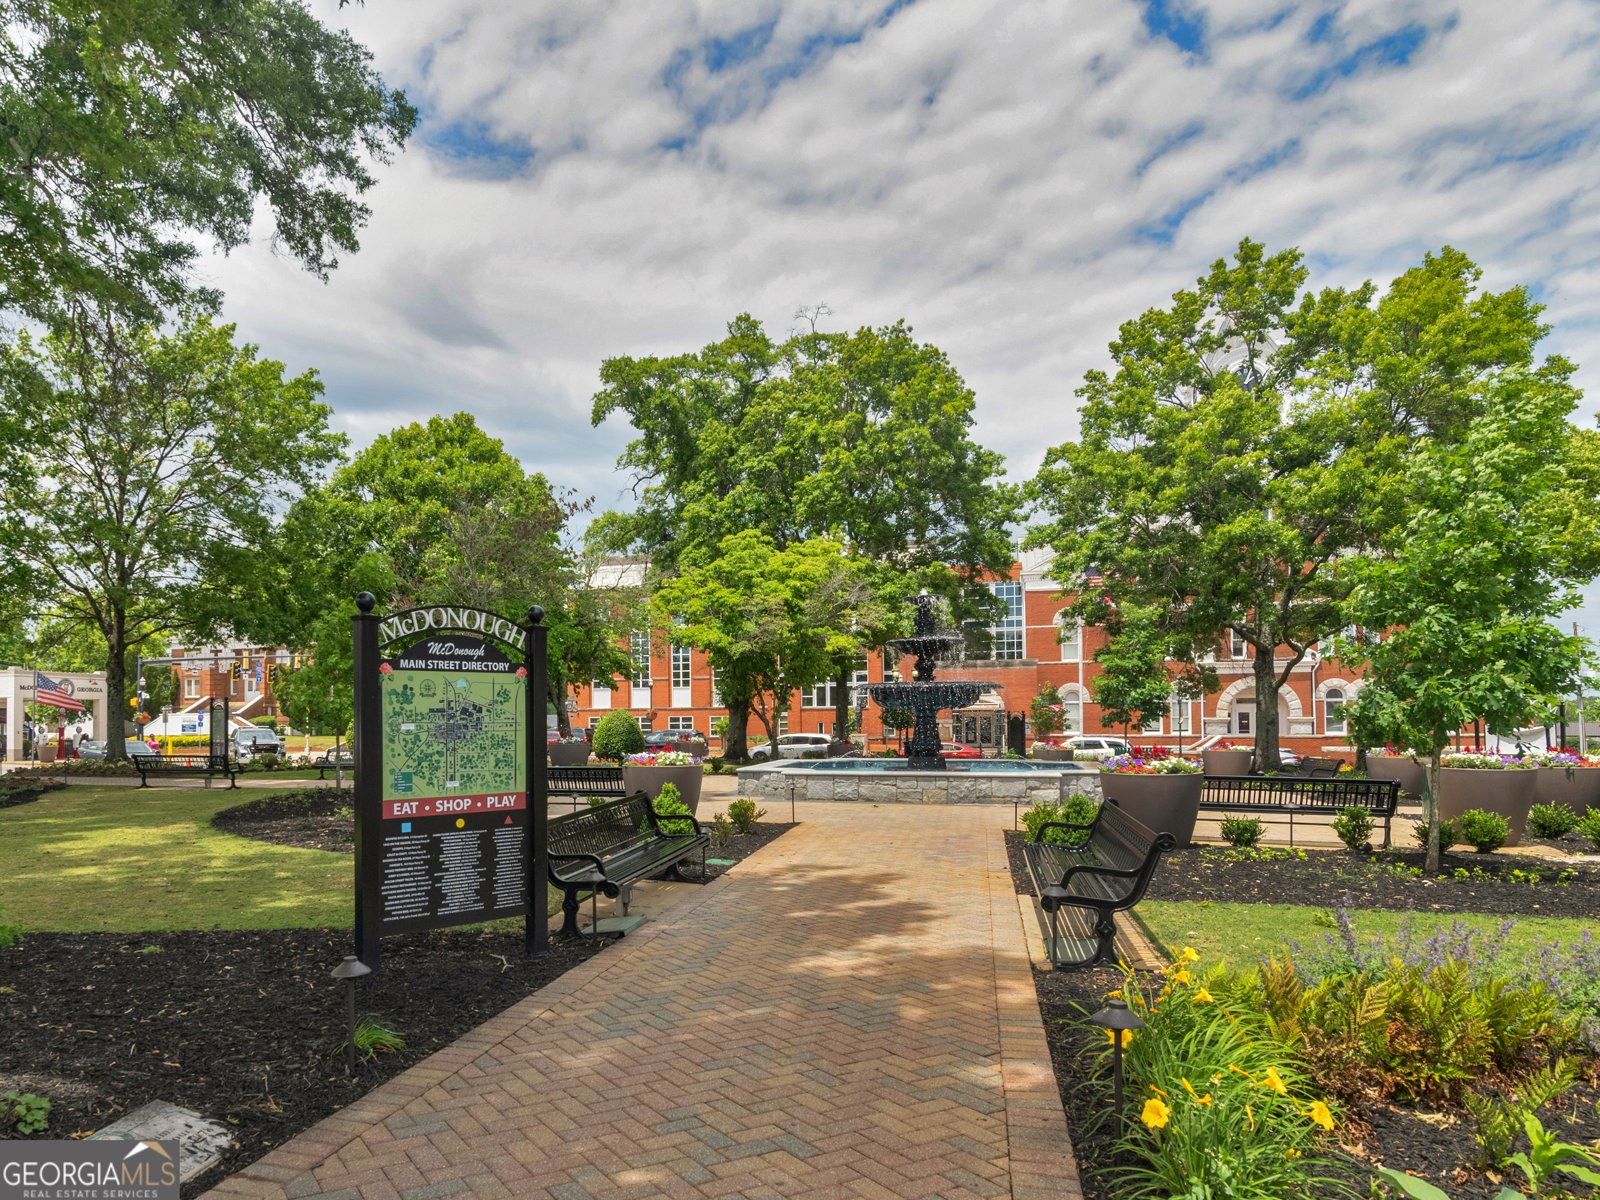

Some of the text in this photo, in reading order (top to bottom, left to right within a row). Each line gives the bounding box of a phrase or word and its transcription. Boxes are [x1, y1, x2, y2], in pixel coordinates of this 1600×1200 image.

[378, 607, 527, 650] McDONOUGH
[427, 641, 485, 661] McDonough
[400, 659, 510, 672] MAIN STREET DIRECTORY
[393, 795, 517, 815] EAT SHOP PLAY
